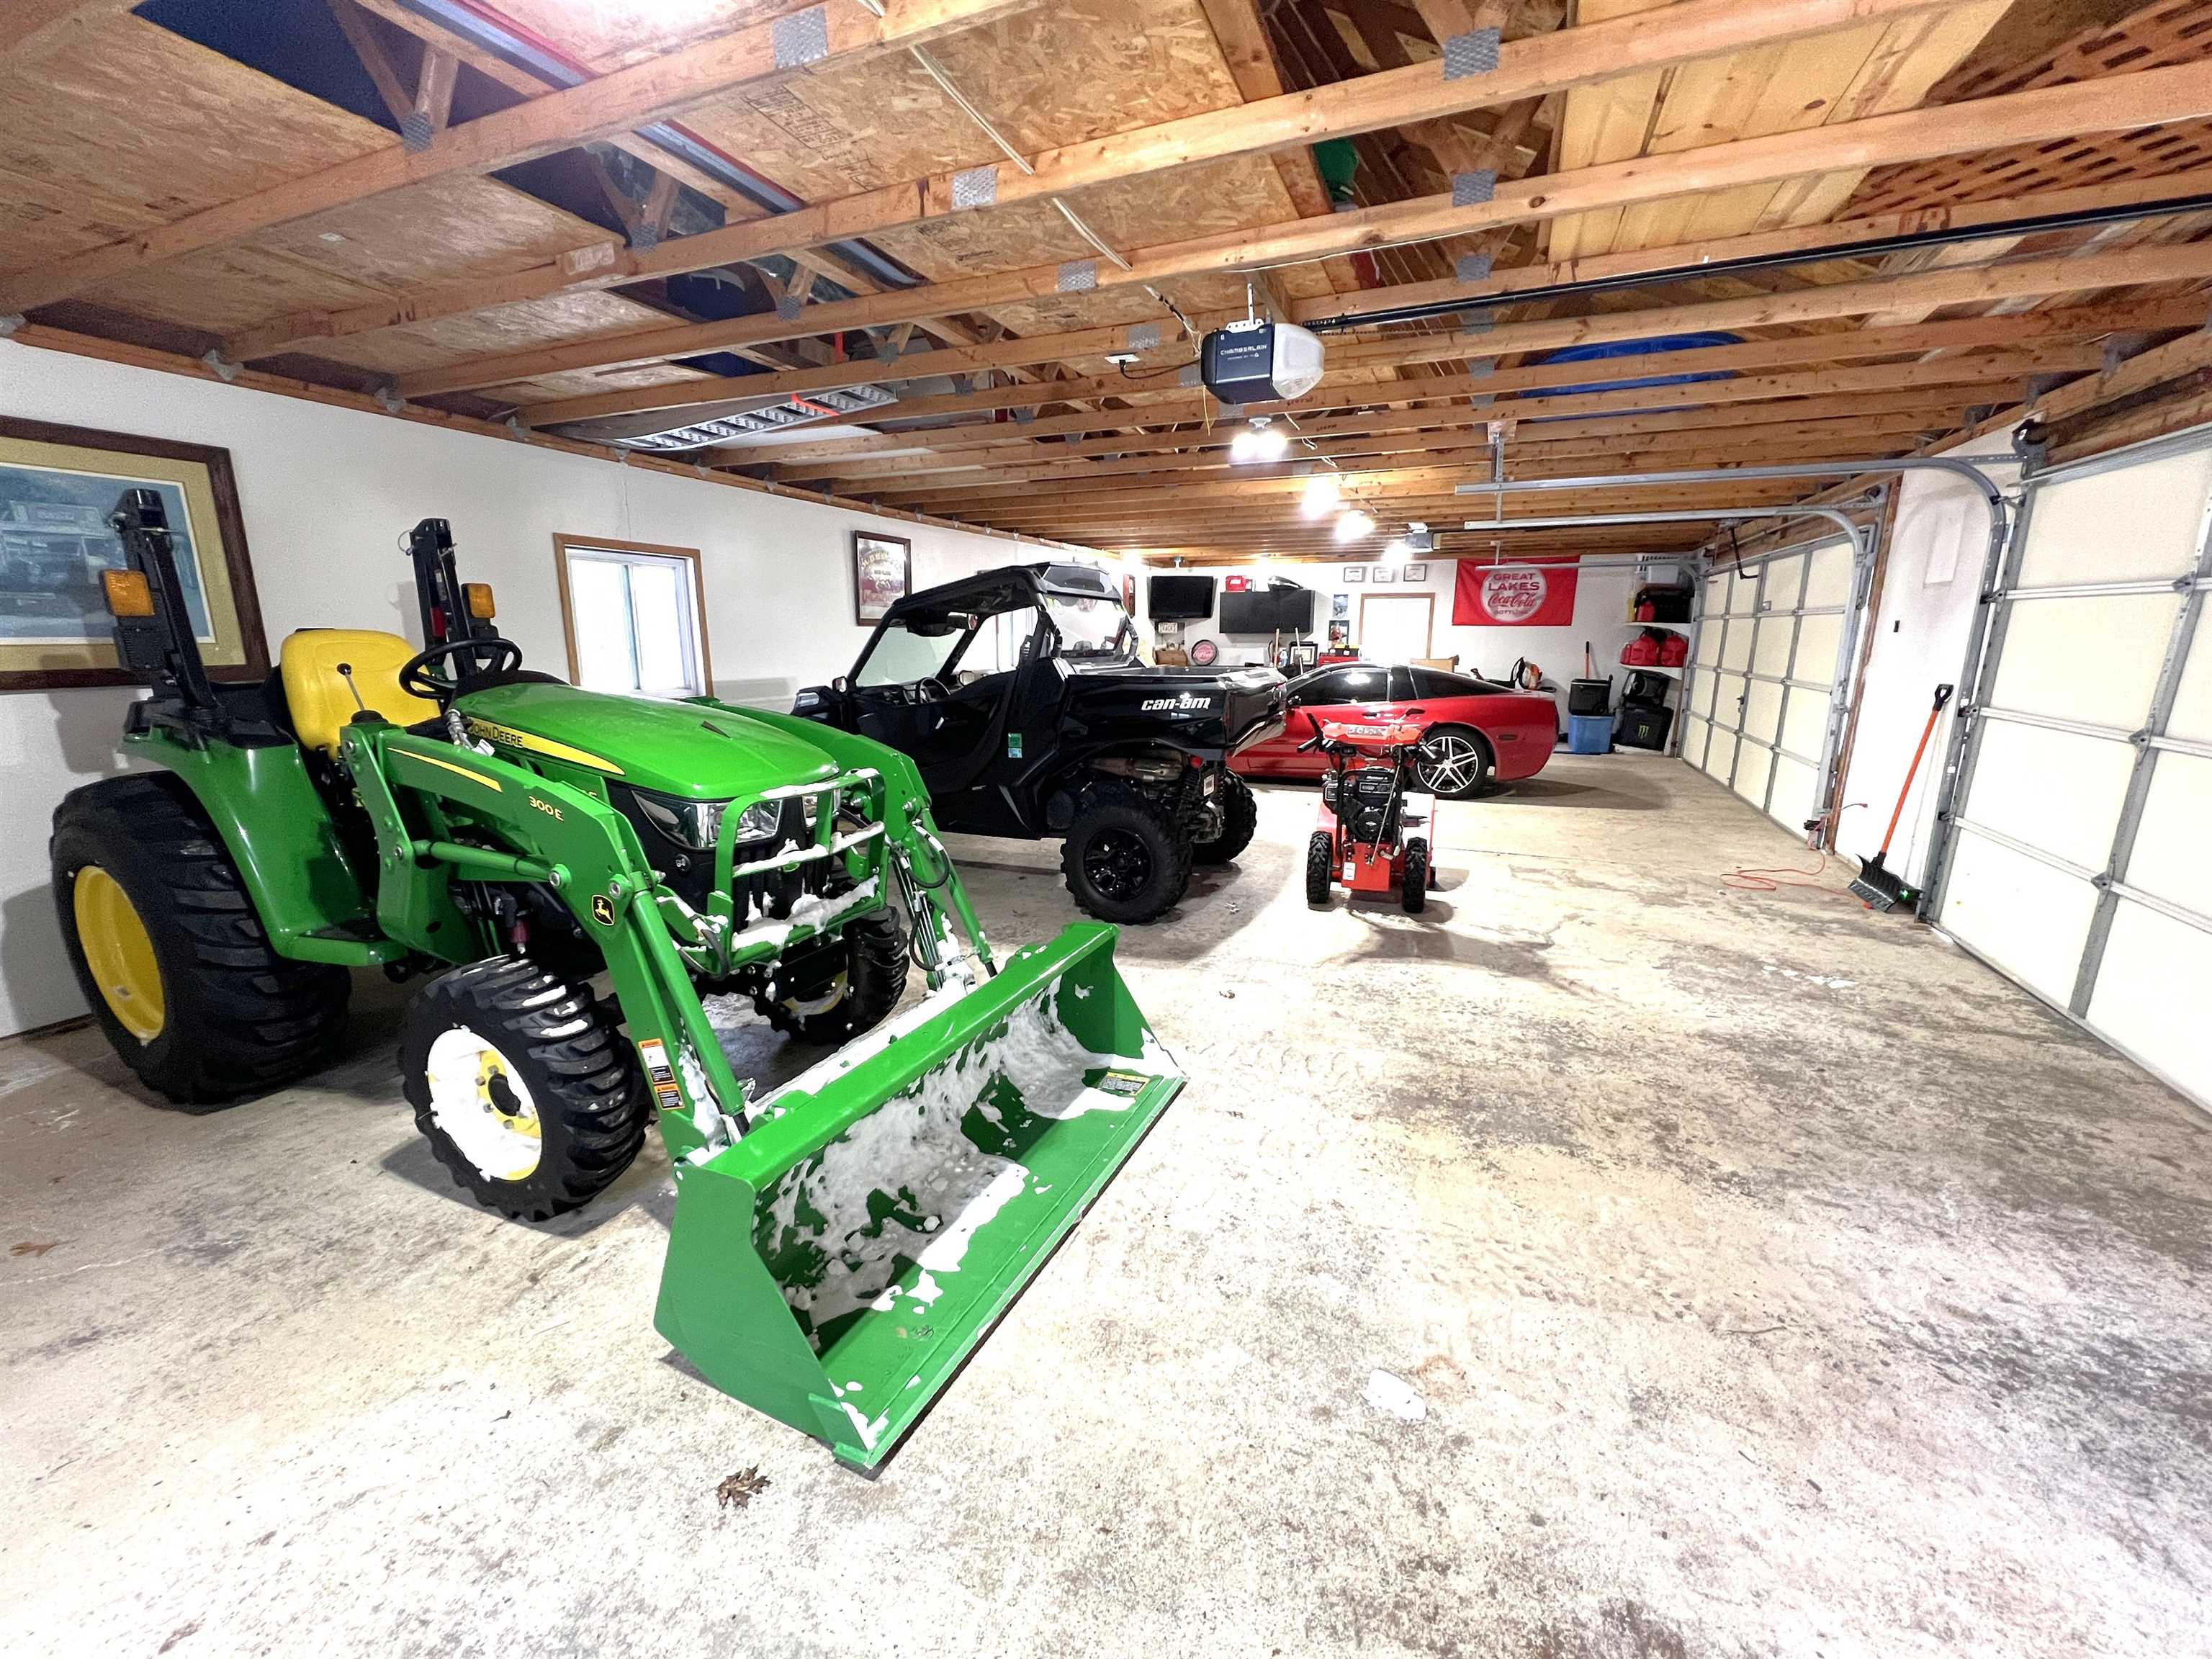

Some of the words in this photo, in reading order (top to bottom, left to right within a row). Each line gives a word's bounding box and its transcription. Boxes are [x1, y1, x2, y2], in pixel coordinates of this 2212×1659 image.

[1488, 582, 1539, 590] LAKES
[469, 722, 492, 739] JOHN
[493, 726, 523, 747] DEERE
